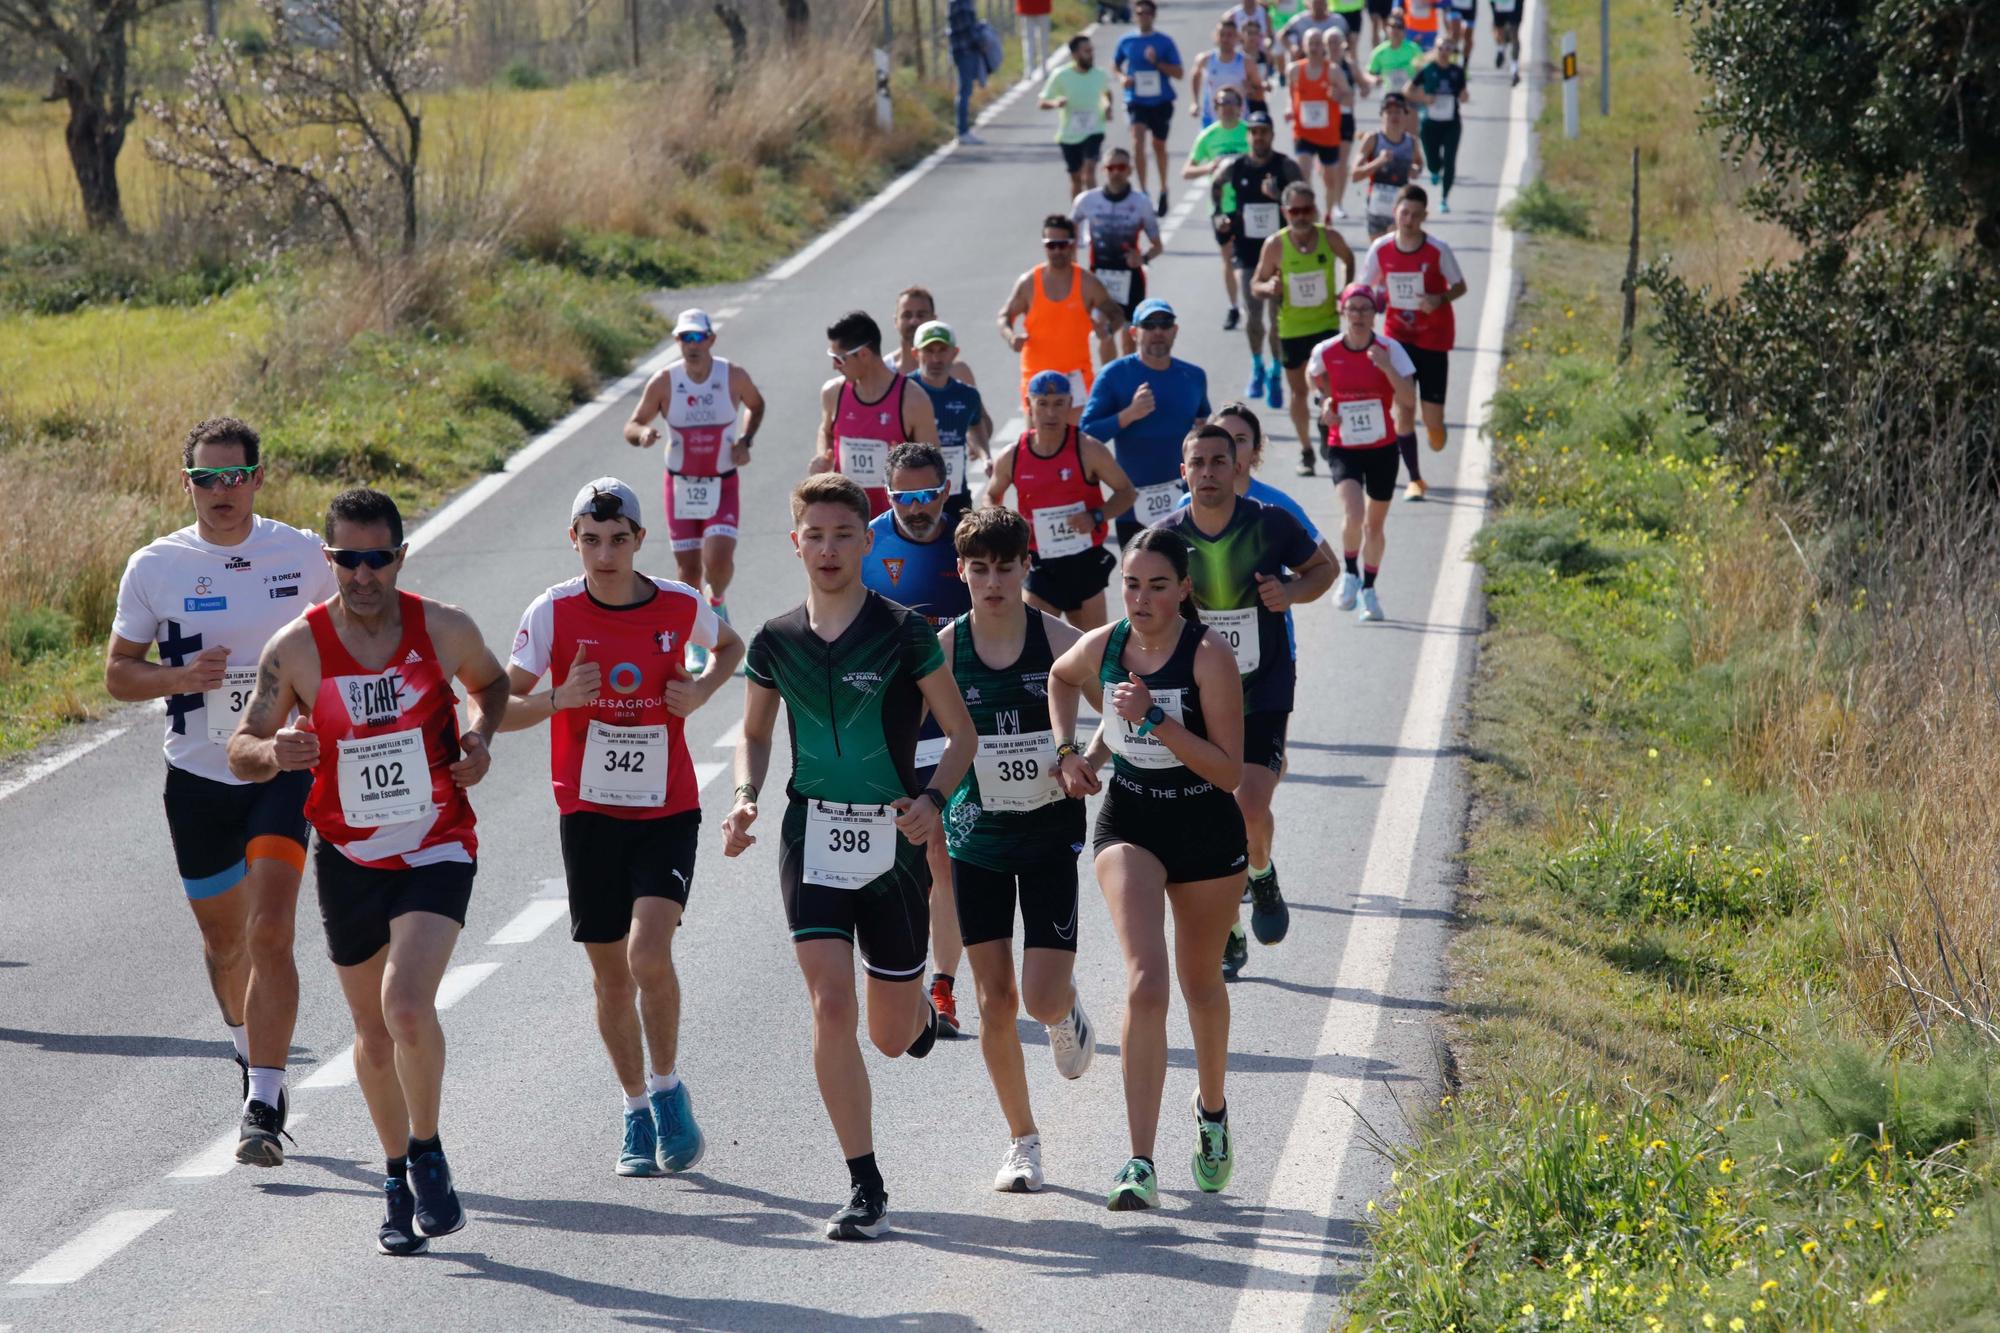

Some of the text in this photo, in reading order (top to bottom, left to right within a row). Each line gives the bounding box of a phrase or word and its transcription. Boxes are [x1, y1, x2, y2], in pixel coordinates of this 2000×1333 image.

[1350, 414, 1371, 426] 141
[851, 454, 874, 468] 101
[686, 488, 707, 501] 129
[1147, 494, 1171, 511] 209
[278, 572, 301, 581] DREAM
[343, 747, 359, 755] CURSA
[360, 745, 372, 753] FLOR
[401, 738, 414, 746] 2023
[983, 741, 998, 750] CURSA
[998, 741, 1009, 749] FLOR
[1037, 737, 1049, 745] 2023
[604, 750, 645, 773] 342
[997, 758, 1039, 782] 389
[360, 761, 405, 790] 102
[361, 787, 410, 802] Emilio Escudero
[1116, 774, 1217, 799] FACE THE NOR
[828, 828, 870, 854] 398
